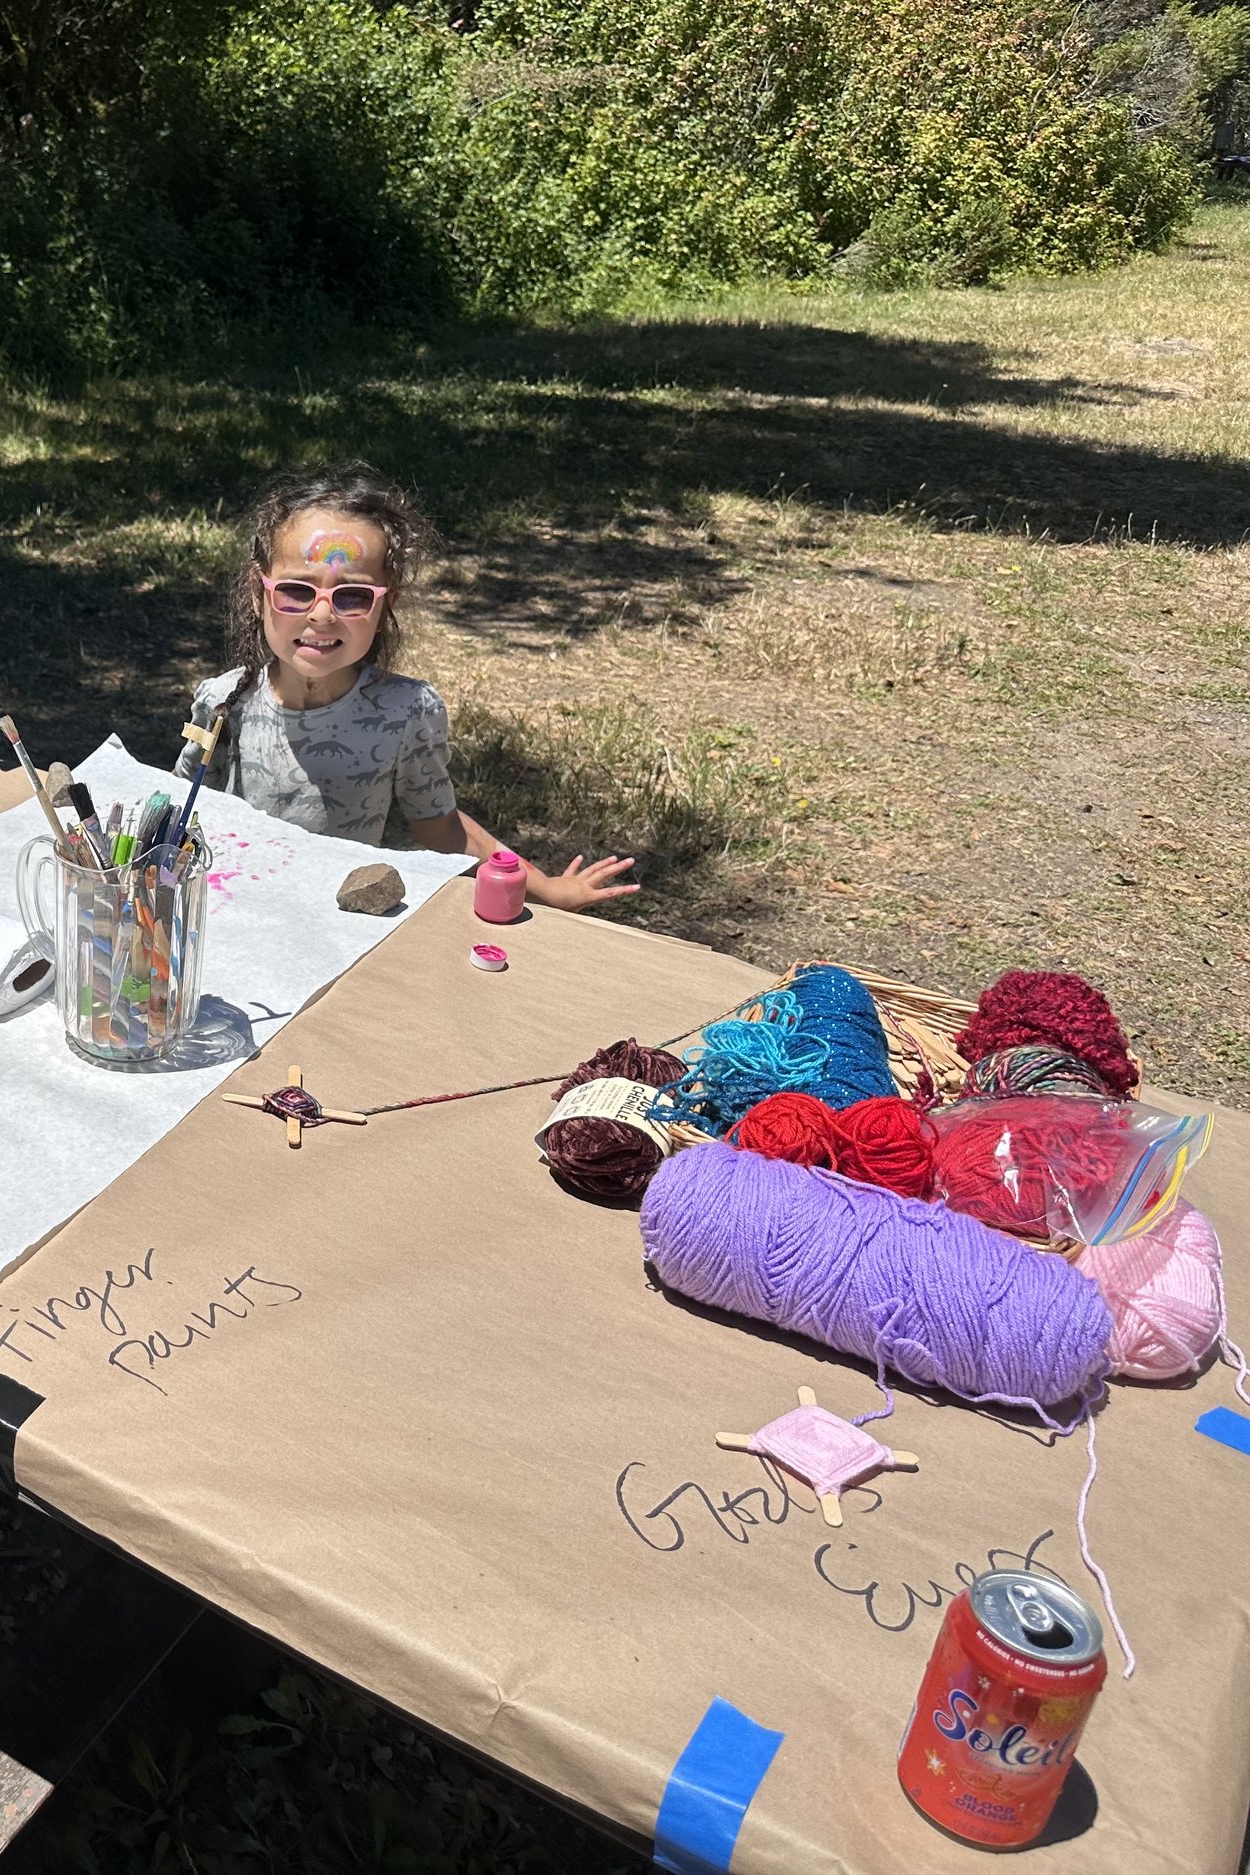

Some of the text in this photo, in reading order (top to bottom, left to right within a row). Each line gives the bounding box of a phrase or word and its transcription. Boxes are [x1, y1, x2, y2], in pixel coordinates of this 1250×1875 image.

[615, 1085, 645, 1121] CHENILLE
[633, 1095, 654, 1121] JUST
[983, 1638, 1011, 1660] CALORIES
[932, 1688, 1078, 1768] Soleil
[954, 1796, 1020, 1823] ORANGE
[962, 1792, 1016, 1815] BLOOD
